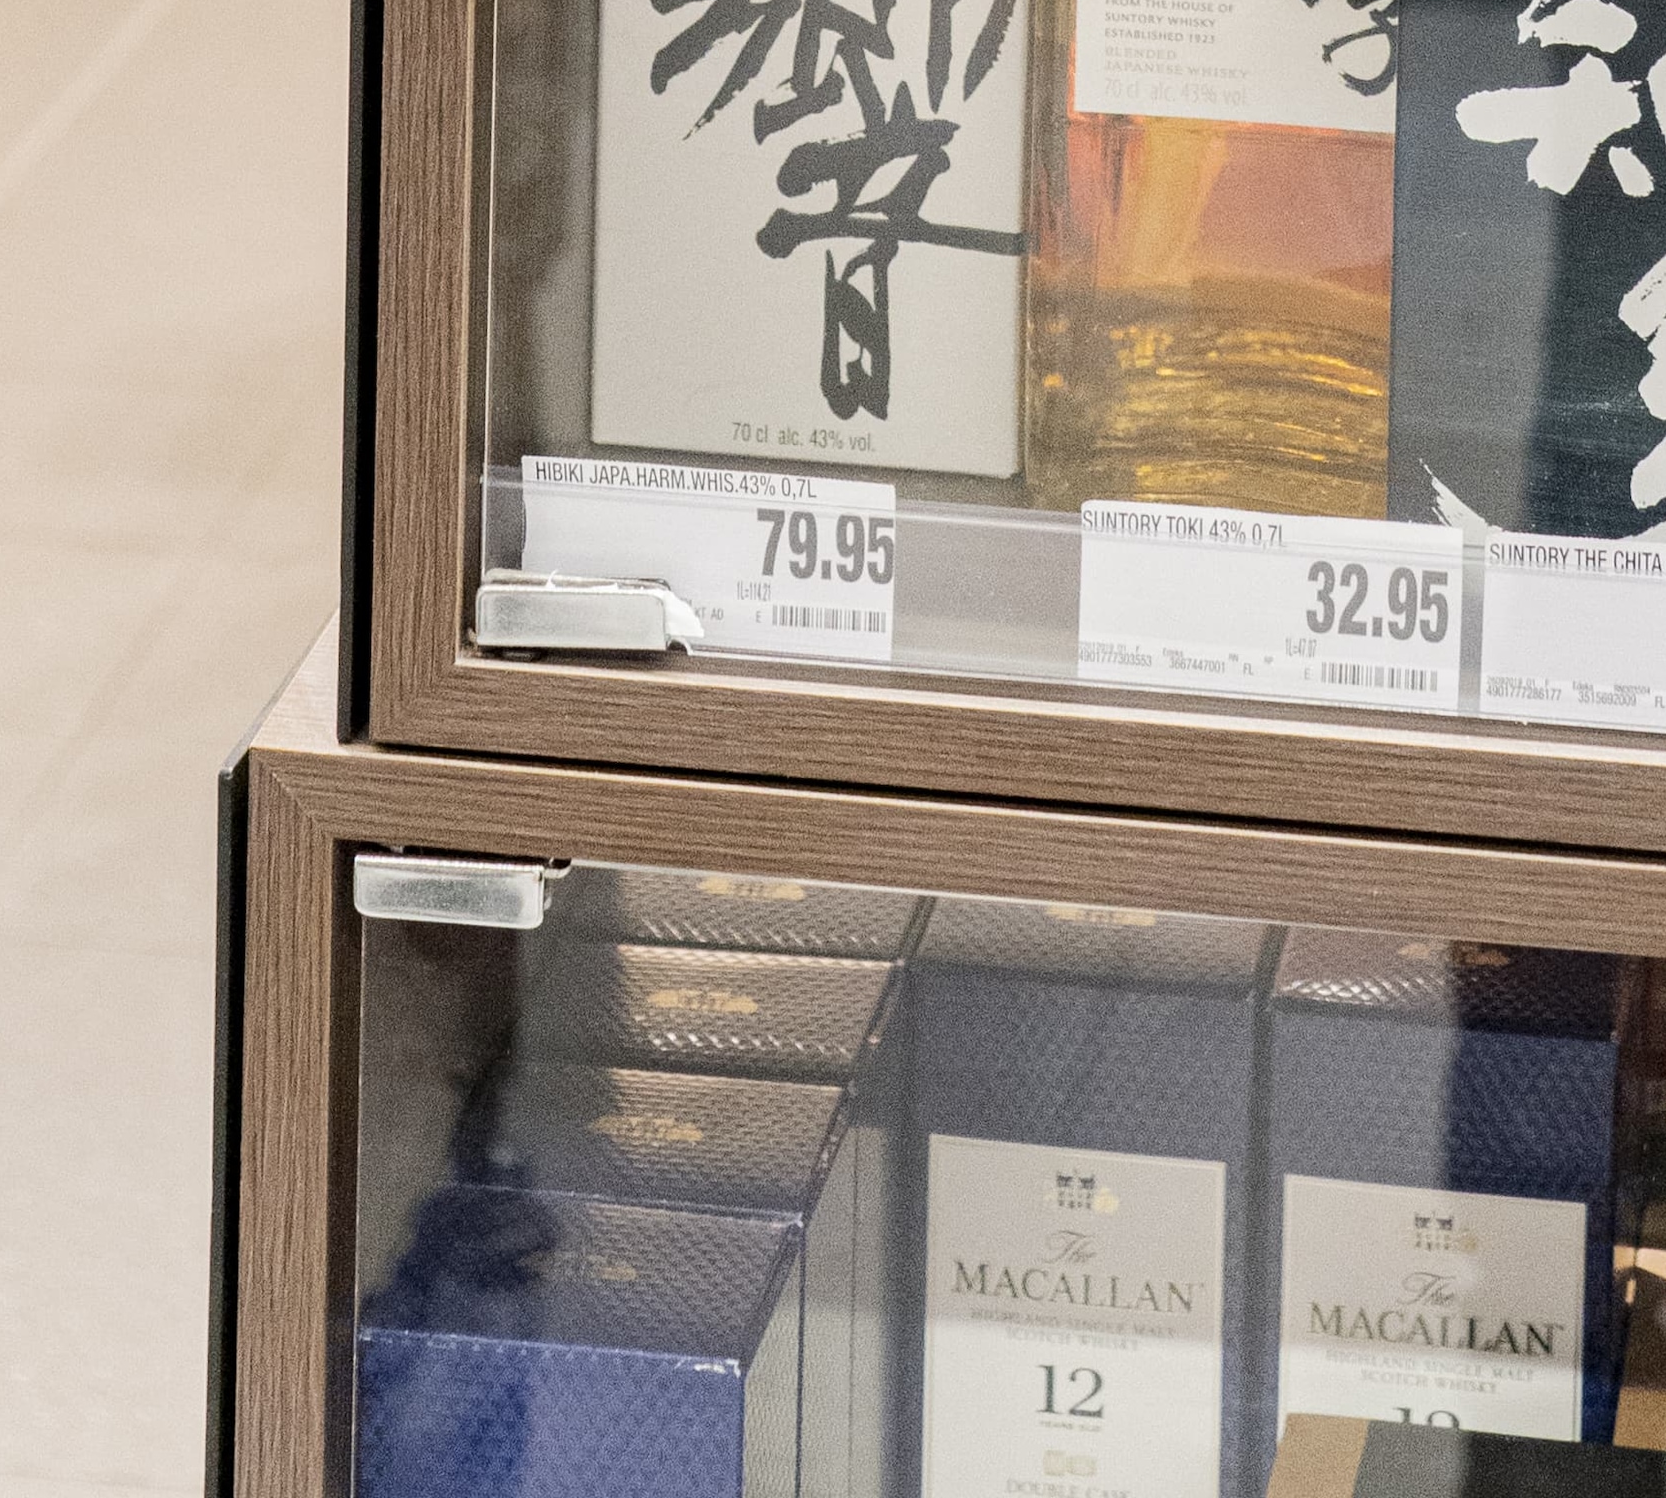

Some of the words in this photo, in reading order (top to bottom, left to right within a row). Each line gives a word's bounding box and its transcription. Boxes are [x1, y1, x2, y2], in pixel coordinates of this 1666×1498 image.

[535, 462, 584, 484] HIBIKI
[782, 477, 817, 499] 0,7L
[757, 508, 894, 585] 79.95
[1306, 561, 1449, 643] 32.95
[952, 1260, 1193, 1313] MACALLAN
[1307, 1302, 1556, 1357] MACALLAN
[1034, 1364, 1104, 1419] 12
